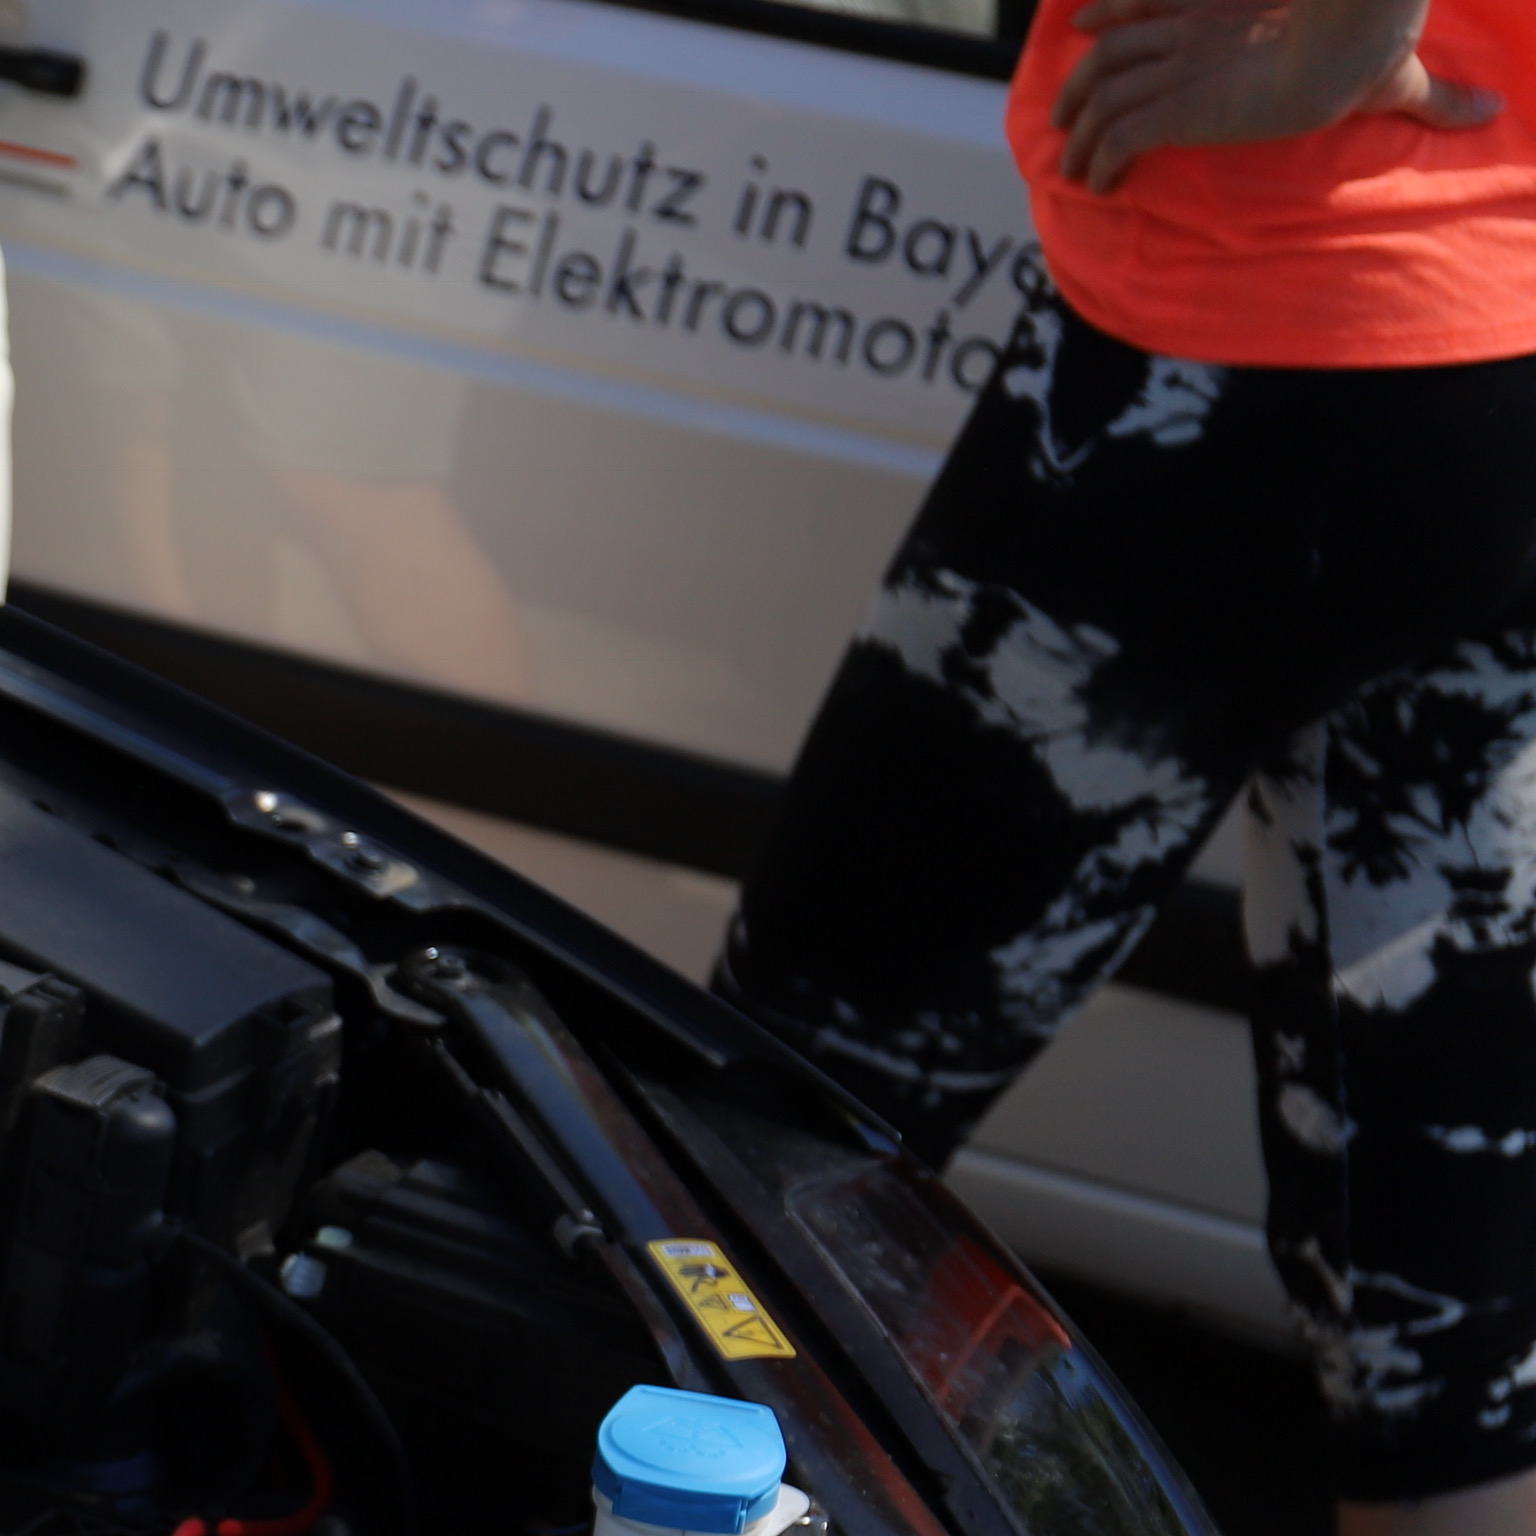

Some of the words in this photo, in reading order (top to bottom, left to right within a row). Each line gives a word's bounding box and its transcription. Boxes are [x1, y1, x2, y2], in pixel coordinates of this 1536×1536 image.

[116, 136, 298, 245] Auto
[321, 191, 460, 276] mit
[140, 30, 702, 228] Umweltschutz
[732, 153, 810, 249] in
